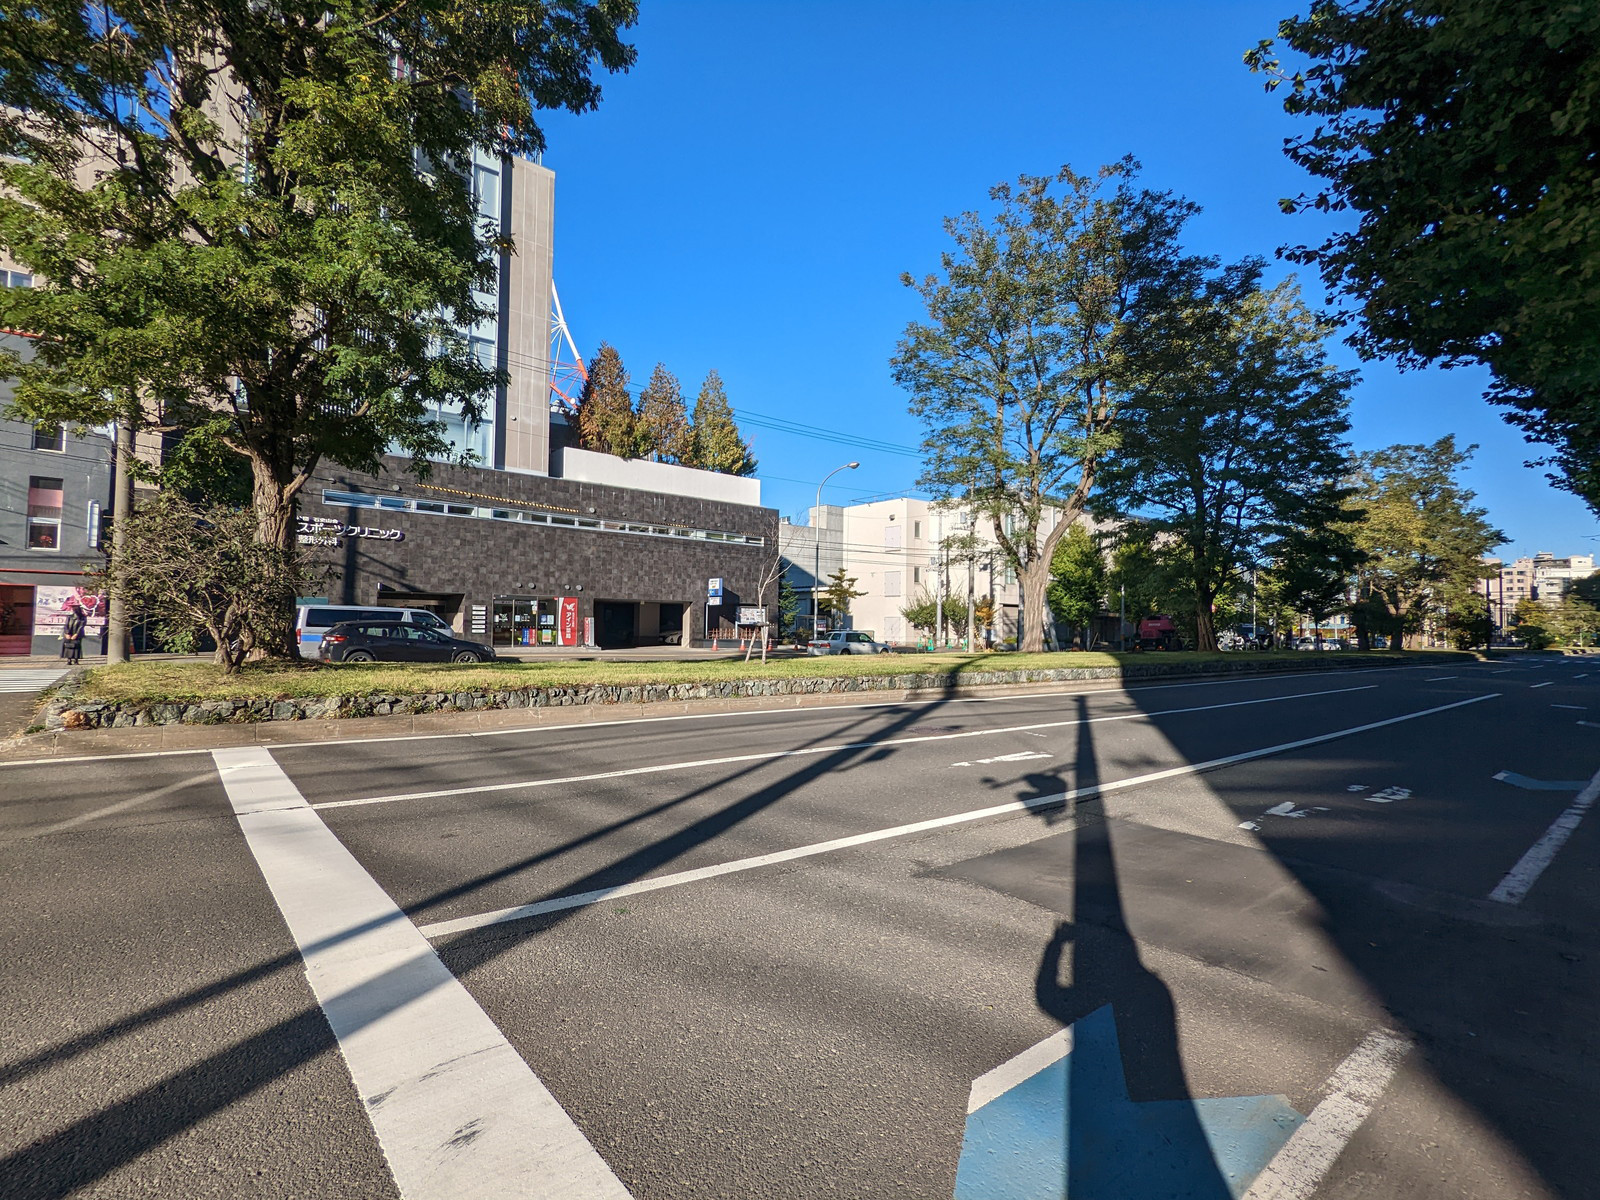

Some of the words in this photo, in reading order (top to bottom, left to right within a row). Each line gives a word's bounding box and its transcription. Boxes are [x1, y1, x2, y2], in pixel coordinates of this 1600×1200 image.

[296, 522, 401, 540] スポーツクリニック
